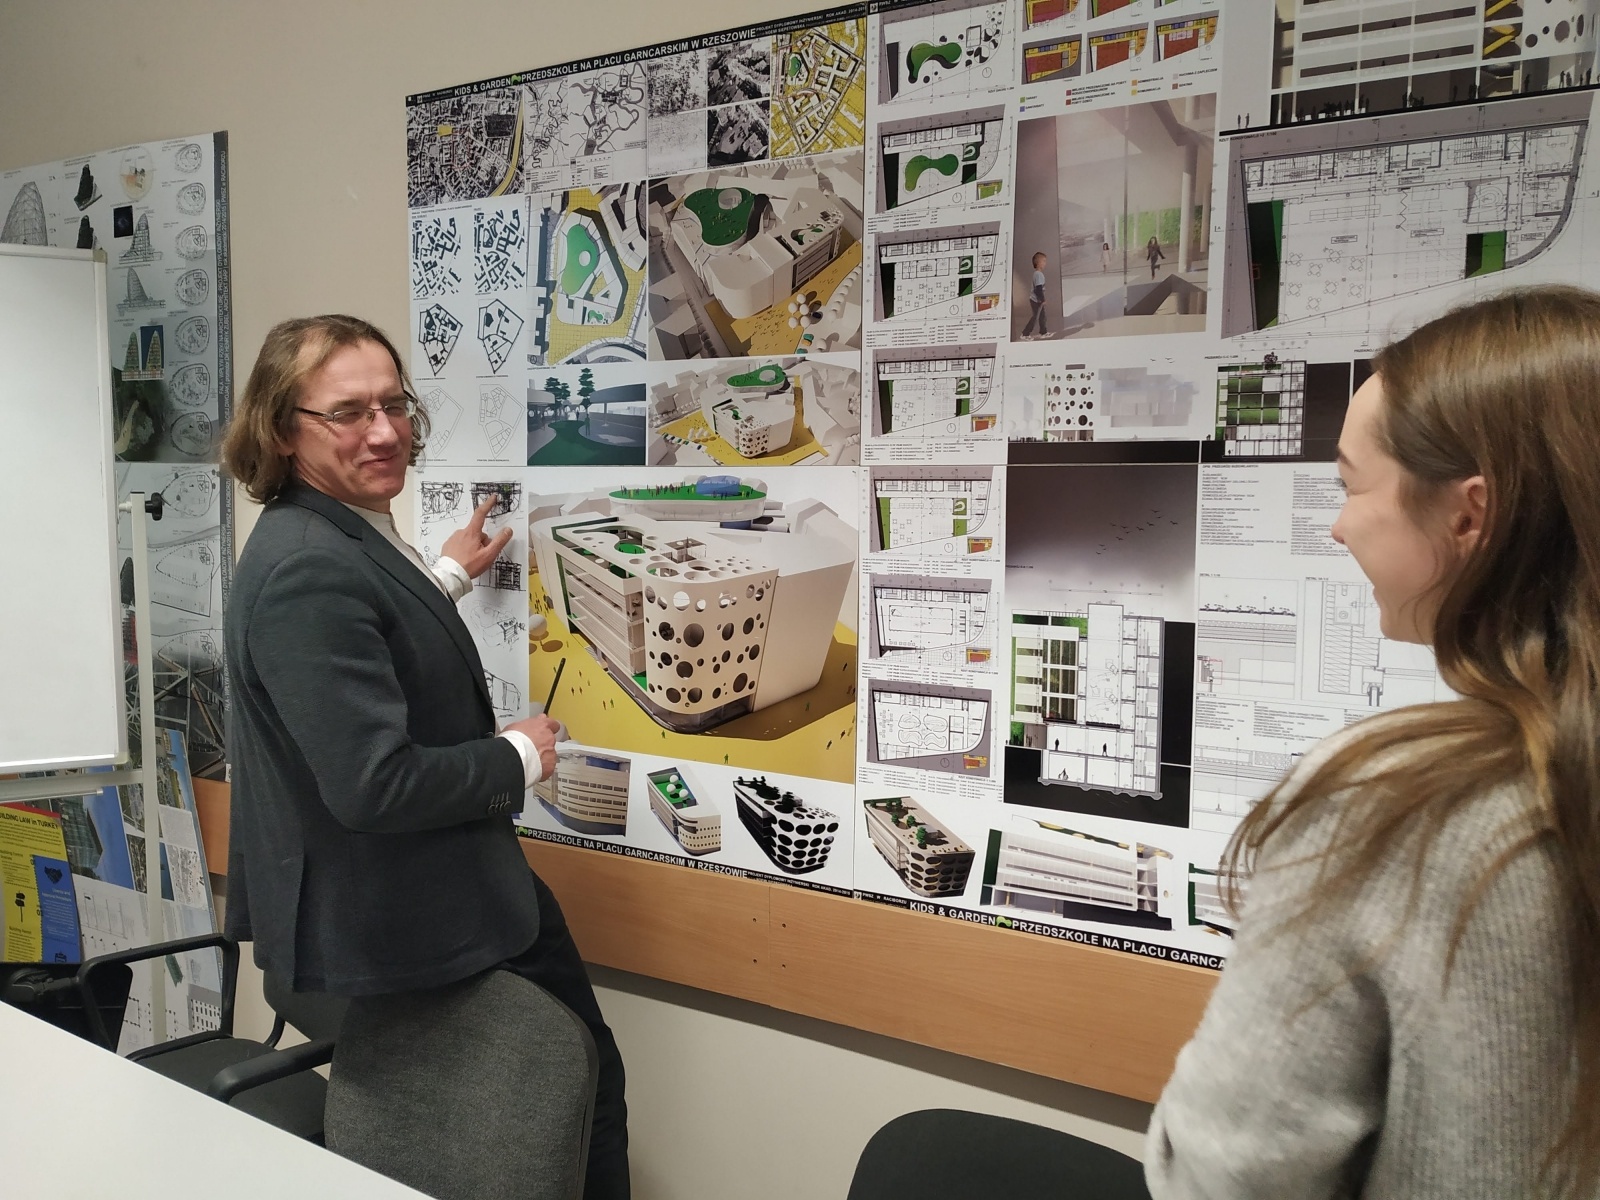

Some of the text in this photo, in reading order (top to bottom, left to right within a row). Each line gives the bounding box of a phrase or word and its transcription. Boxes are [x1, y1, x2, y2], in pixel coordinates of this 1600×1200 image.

[454, 85, 471, 96] KIDS
[473, 84, 479, 92] &
[480, 77, 511, 91] GARDEN
[521, 63, 578, 83] PRZEDSZKOLE
[580, 62, 592, 72] NA
[594, 54, 622, 68] PLACU
[624, 41, 689, 62] GARNCARSKIM
[691, 39, 700, 49] W
[702, 28, 757, 47] RZESZOWIE
[37, 819, 59, 829] TURKEY
[527, 829, 582, 847] PRZEDSZKOLE
[583, 840, 595, 849] NA
[596, 841, 623, 855] PLACU
[624, 847, 685, 867] GARNCARSKIM
[687, 859, 696, 868] W
[697, 862, 748, 879] RZESZOWIE
[883, 896, 907, 905] RACIBORZU
[909, 901, 935, 914] KIDS
[938, 907, 946, 917] &
[949, 908, 996, 926] GARDEN
[1012, 920, 1099, 945] PRZEDSZKOLE
[1102, 937, 1120, 949] NA
[1123, 941, 1166, 958] PLACU
[1170, 950, 1225, 969] GARNCA
